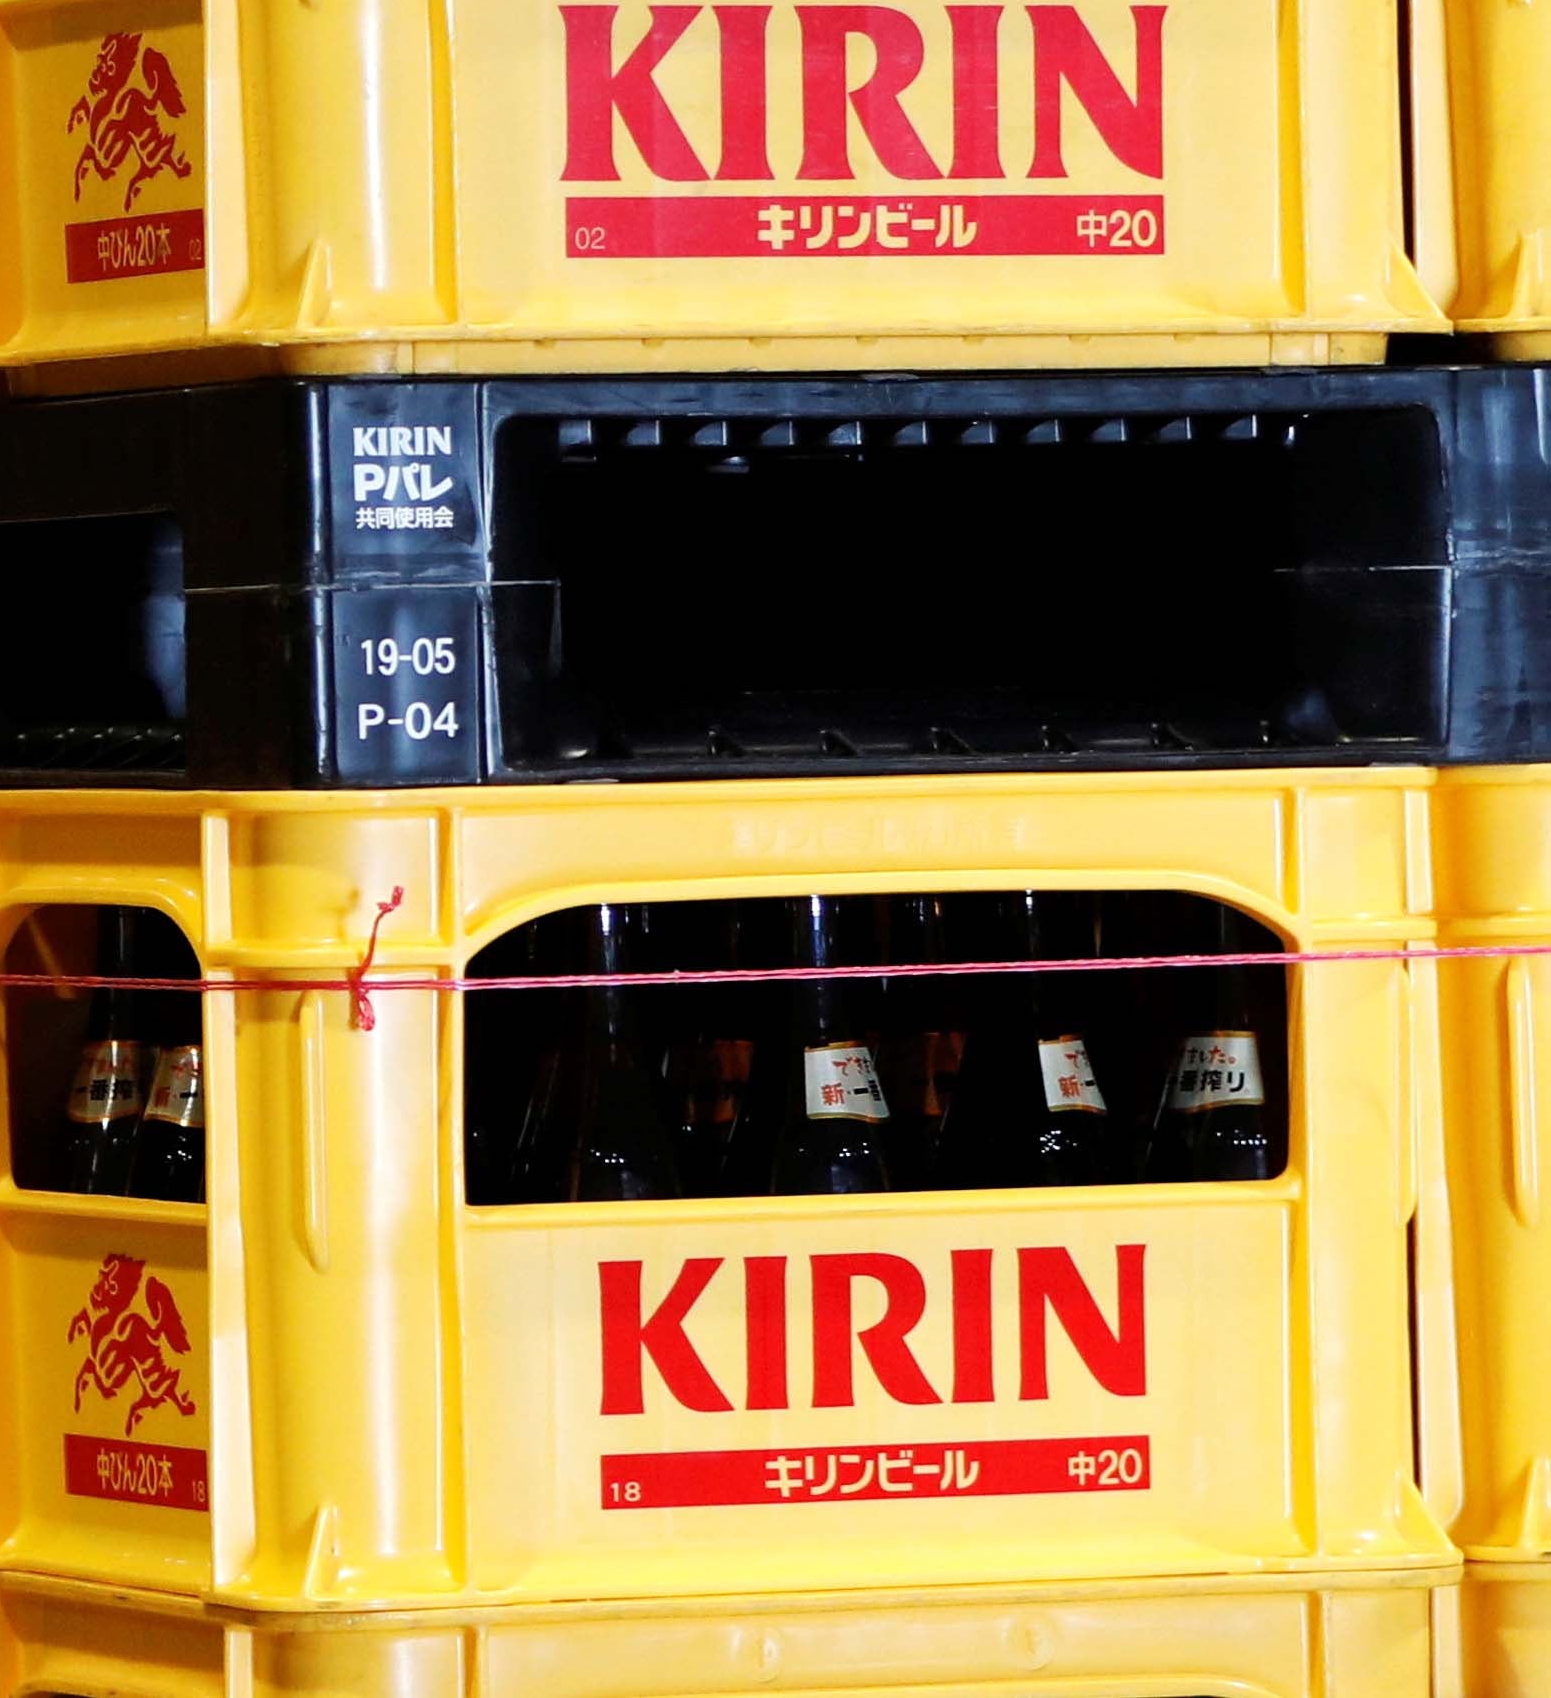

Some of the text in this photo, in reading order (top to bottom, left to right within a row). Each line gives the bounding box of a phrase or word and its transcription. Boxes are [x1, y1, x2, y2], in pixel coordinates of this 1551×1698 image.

[560, 5, 1167, 182] KIRIN
[97, 222, 172, 272] 中びん20本
[575, 202, 1158, 251] 02 キリンビール 中20
[352, 426, 452, 457] KIRIN
[353, 462, 453, 502] Pパレ
[356, 505, 454, 530] 共同使用会
[361, 637, 456, 676] 19-05
[358, 701, 459, 740] P-04
[599, 1243, 1147, 1416] KIRIN
[97, 1447, 207, 1503] 中びん20本 18
[611, 1447, 1143, 1502] 18 キリンビール 中20
